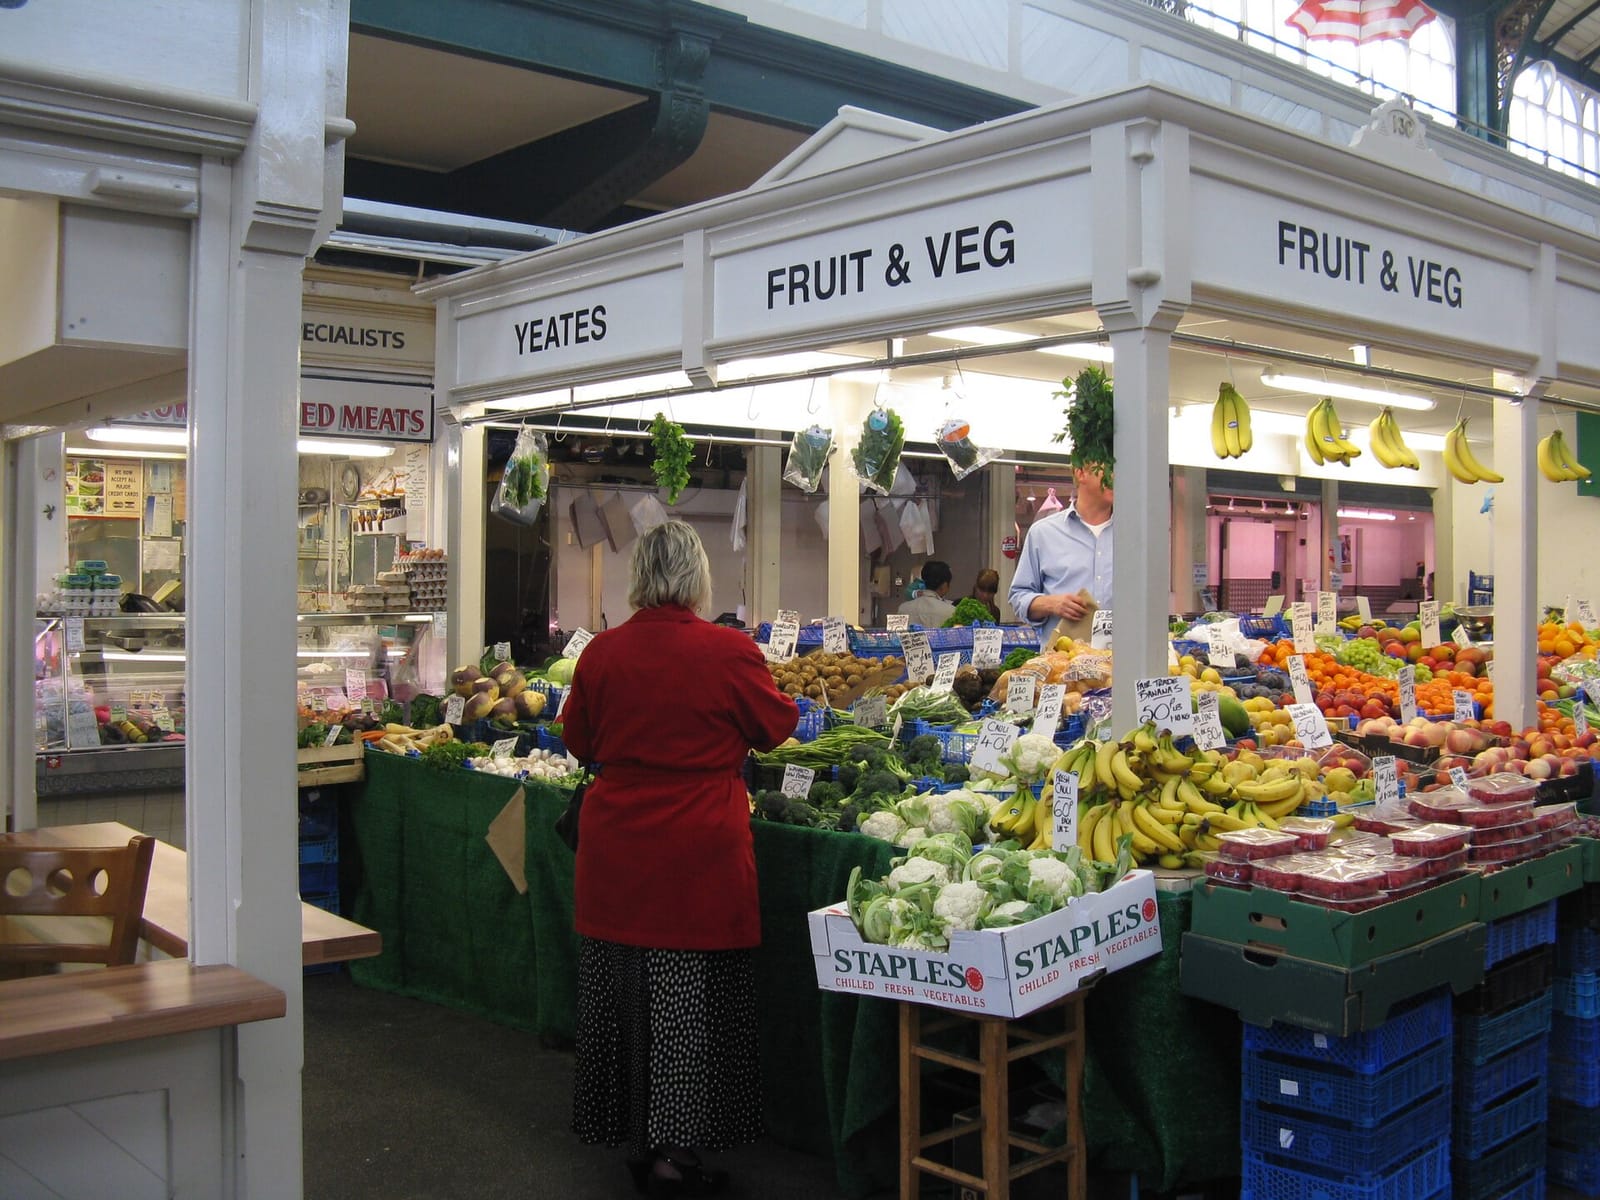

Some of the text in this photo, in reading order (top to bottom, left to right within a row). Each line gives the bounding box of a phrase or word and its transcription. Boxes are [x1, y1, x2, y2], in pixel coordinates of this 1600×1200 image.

[767, 219, 1016, 309] FRUIT & VEG
[1278, 220, 1462, 309] FRUIT & VEG
[301, 322, 405, 349] ECIALISTS
[514, 304, 608, 356] YEATES
[342, 404, 425, 434] MEATS
[1136, 676, 1178, 692] FAIR TRADE
[1137, 684, 1183, 703] BANANAS
[1014, 902, 1143, 980] STAPLES
[1018, 924, 1159, 996] CHILLED FRESH VEGETABLES
[834, 948, 967, 989] STAPLES
[835, 977, 986, 1009] CHILLED FRESH VEGETABLES
